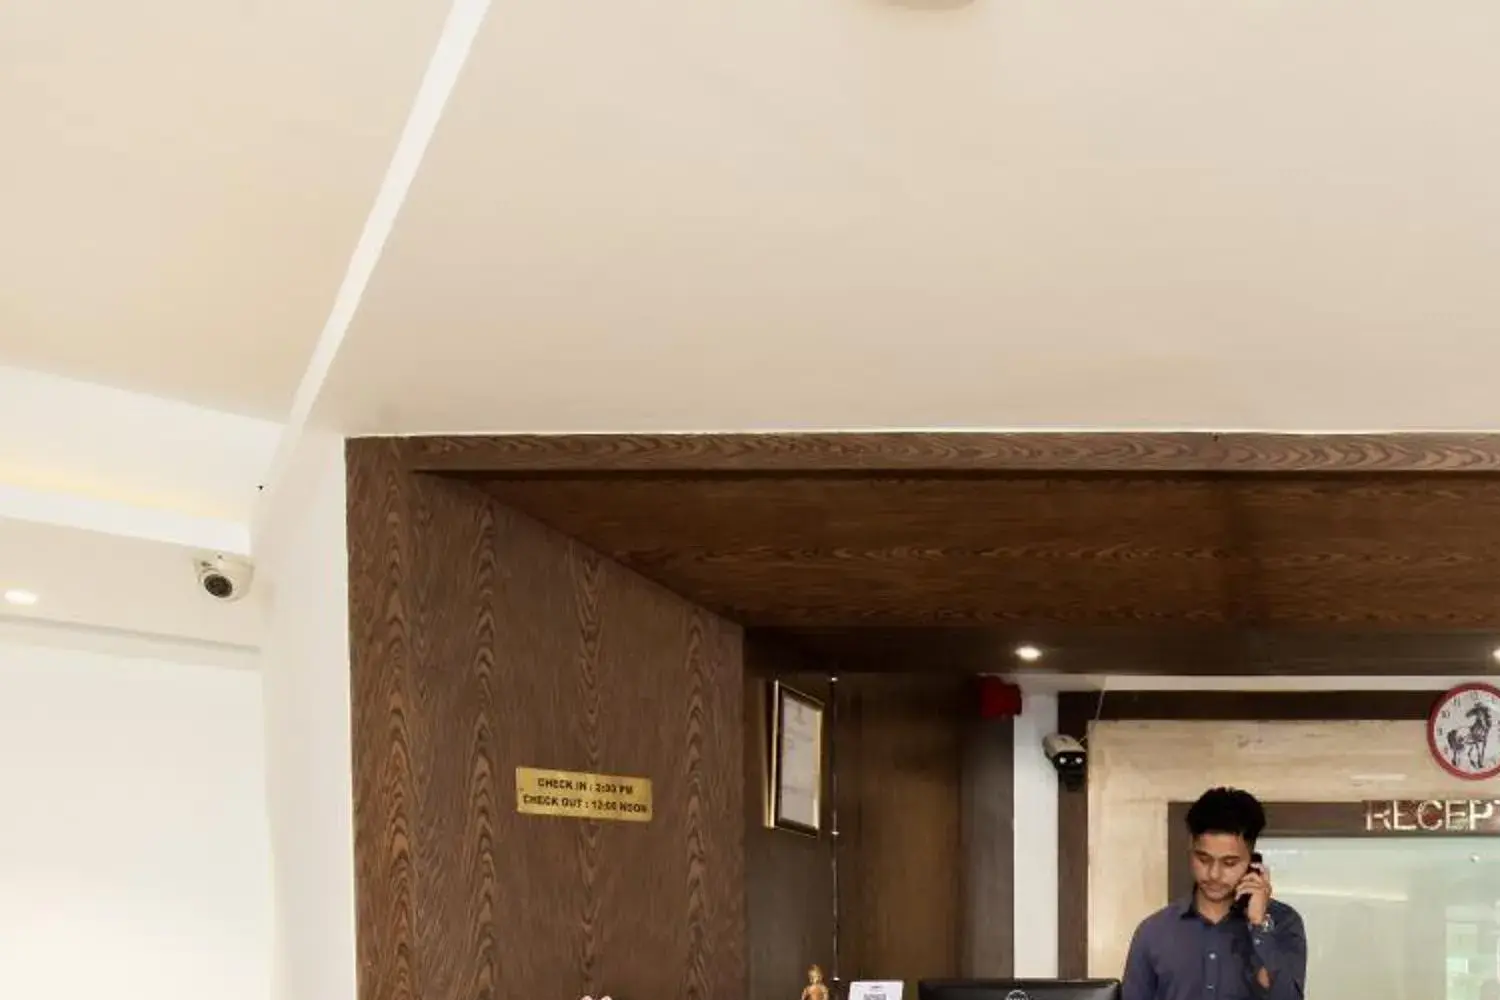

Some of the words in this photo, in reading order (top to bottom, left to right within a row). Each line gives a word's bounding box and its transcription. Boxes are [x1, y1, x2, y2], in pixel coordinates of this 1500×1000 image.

[537, 777, 573, 790] CHECK
[575, 781, 587, 791] IN
[619, 784, 634, 795] PM
[522, 794, 559, 807] CHECK
[561, 797, 583, 809] OUT
